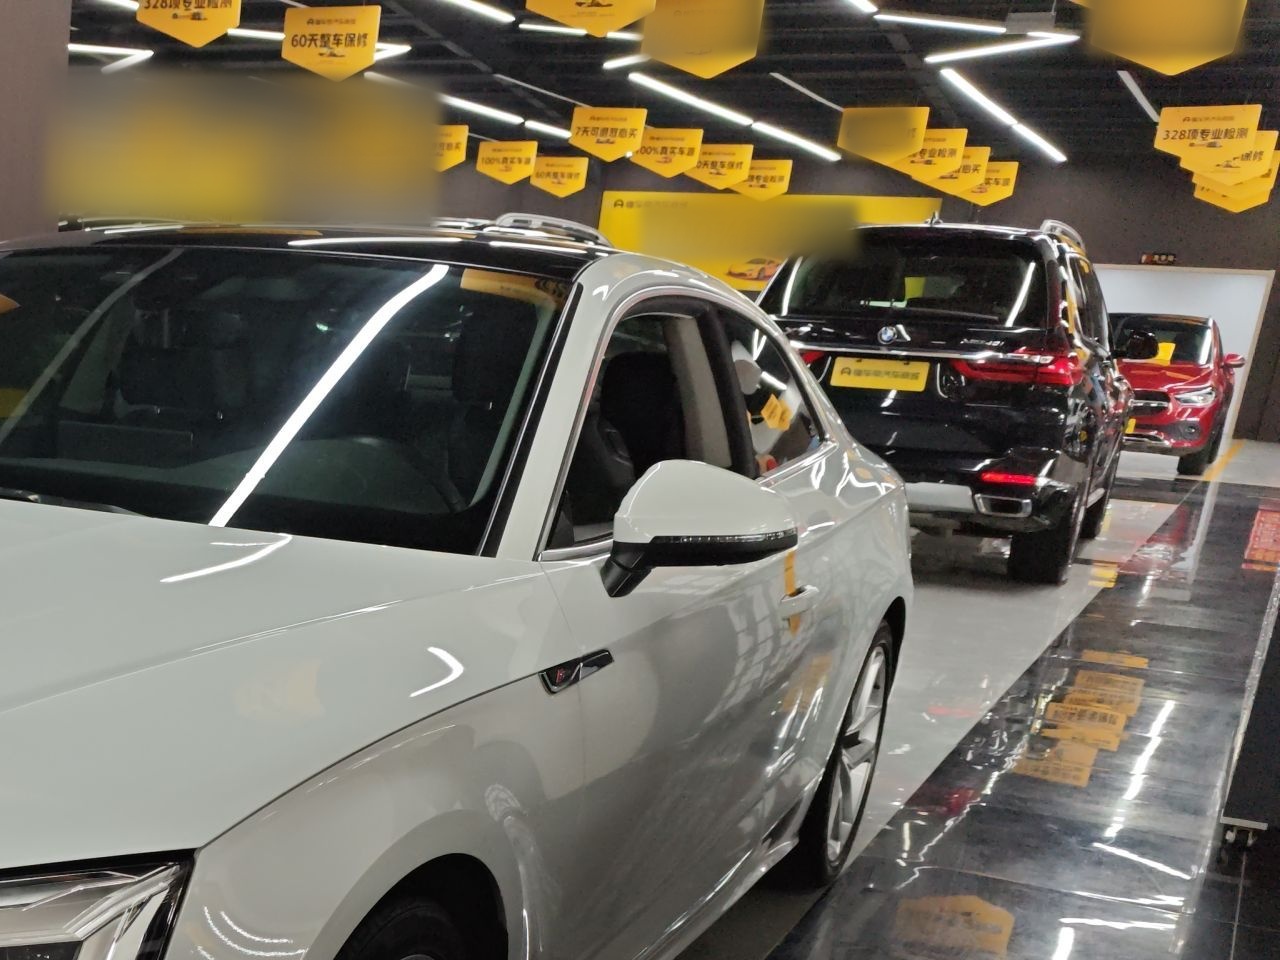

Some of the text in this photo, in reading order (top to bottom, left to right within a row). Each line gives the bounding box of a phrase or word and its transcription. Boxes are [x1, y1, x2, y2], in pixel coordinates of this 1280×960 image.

[291, 32, 369, 49] 60天整车保修
[1162, 127, 1250, 142] 328项专业检测
[1233, 150, 1265, 162] 保修
[696, 160, 744, 170] 0天整车保修
[982, 177, 1011, 187] 实车源
